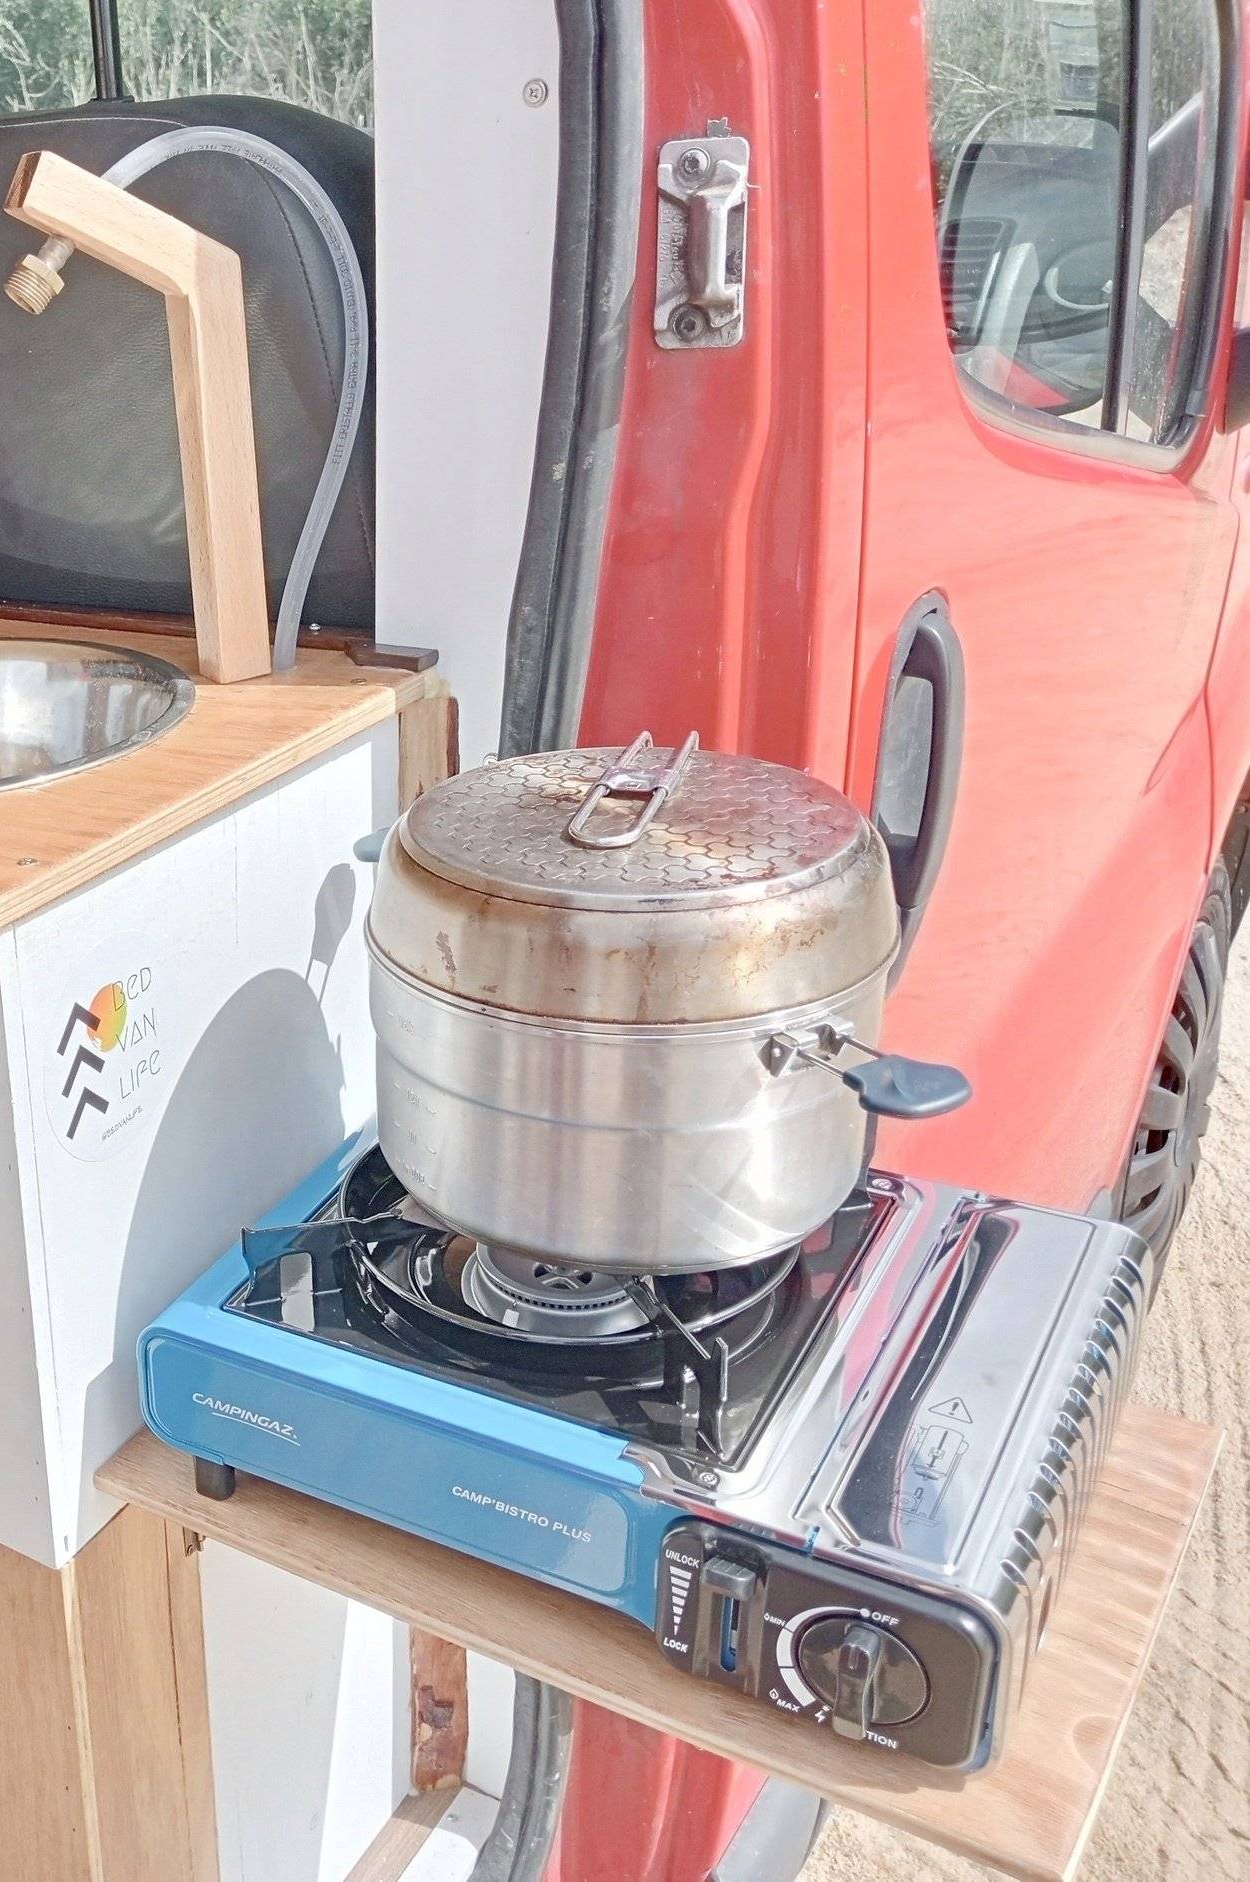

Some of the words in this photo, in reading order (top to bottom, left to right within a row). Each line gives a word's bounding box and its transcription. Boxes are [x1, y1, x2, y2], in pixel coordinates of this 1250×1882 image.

[116, 1008, 158, 1052] VAN
[451, 1485, 550, 1528] CAMP'BISTRO
[552, 1520, 592, 1543] PLUS
[665, 1549, 701, 1569] UNLOCK
[871, 1611, 899, 1626] OFF
[663, 1636, 690, 1653] LOCK
[776, 1698, 801, 1713] MAX
